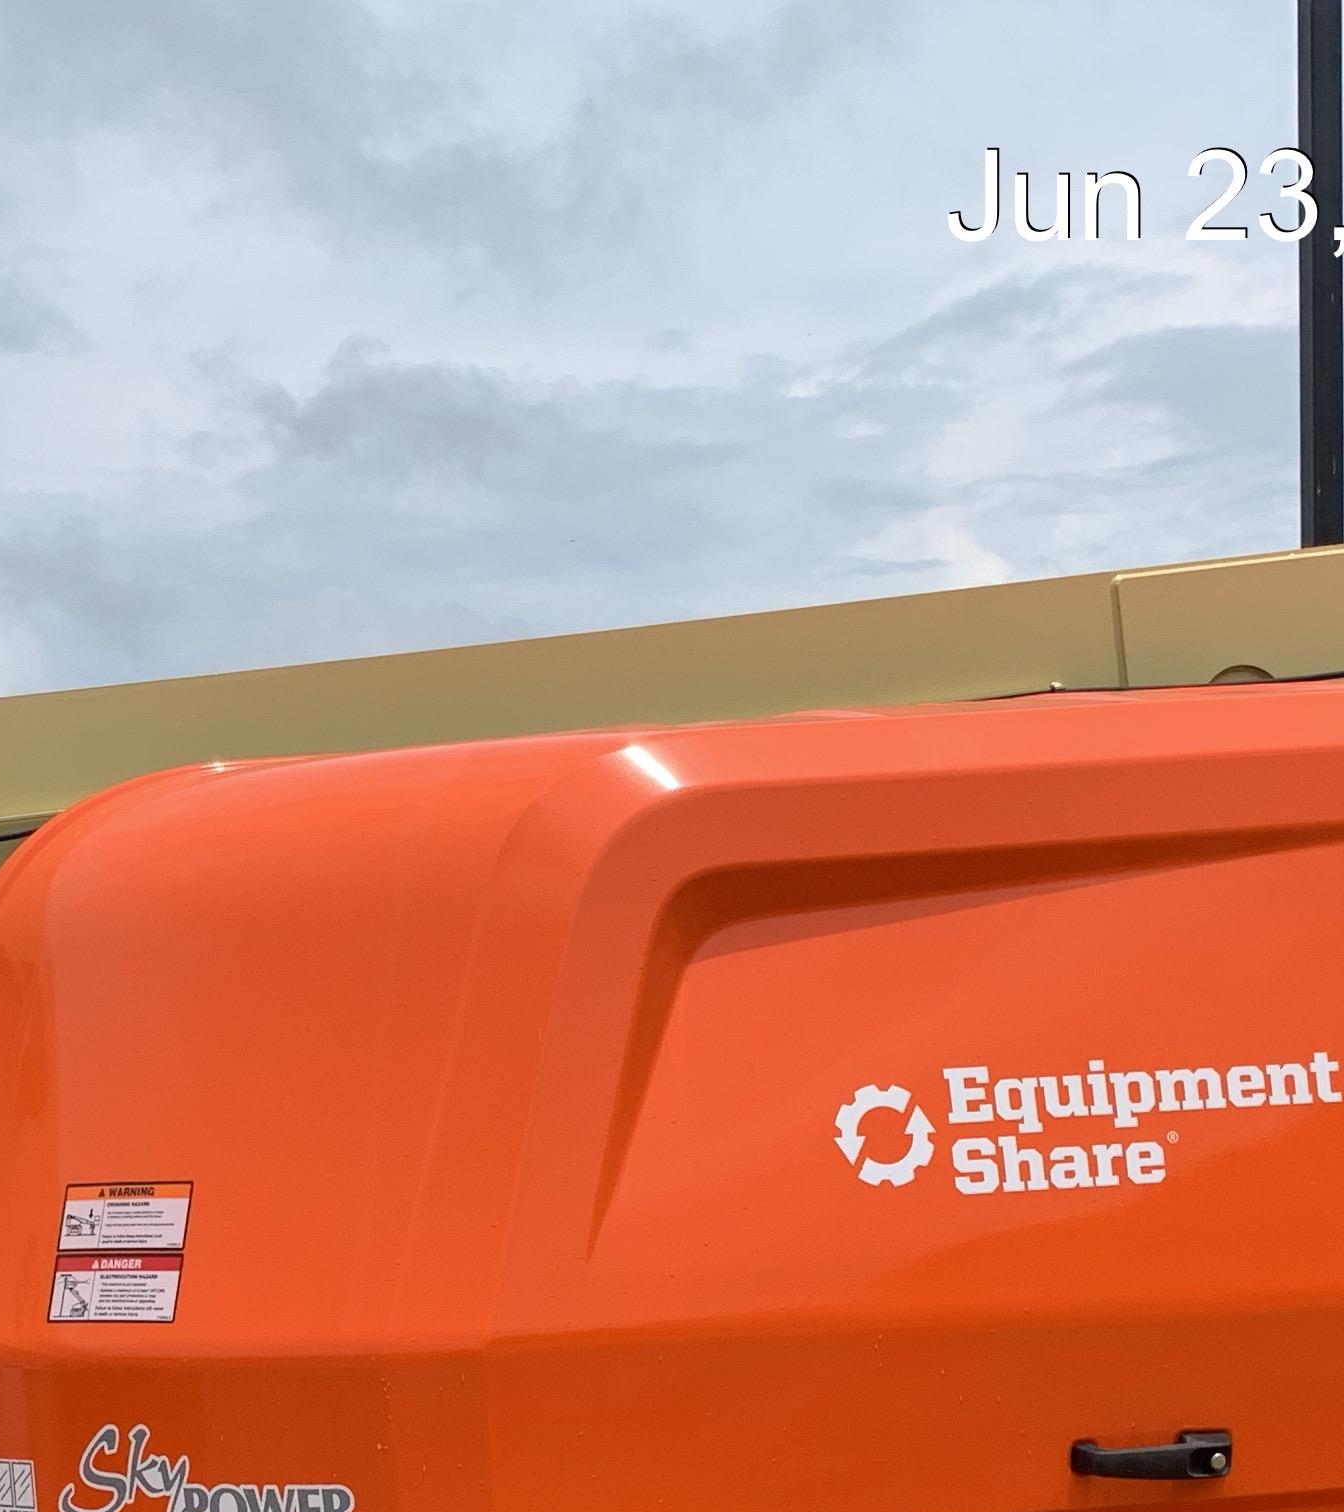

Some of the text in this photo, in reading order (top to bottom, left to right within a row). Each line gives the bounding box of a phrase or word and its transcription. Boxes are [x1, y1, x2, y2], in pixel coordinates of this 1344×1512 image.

[943, 1051, 1342, 1134] Equipment
[951, 1134, 1166, 1195] Share
[109, 1187, 155, 1197] WARNING
[100, 1259, 143, 1269] DANGER
